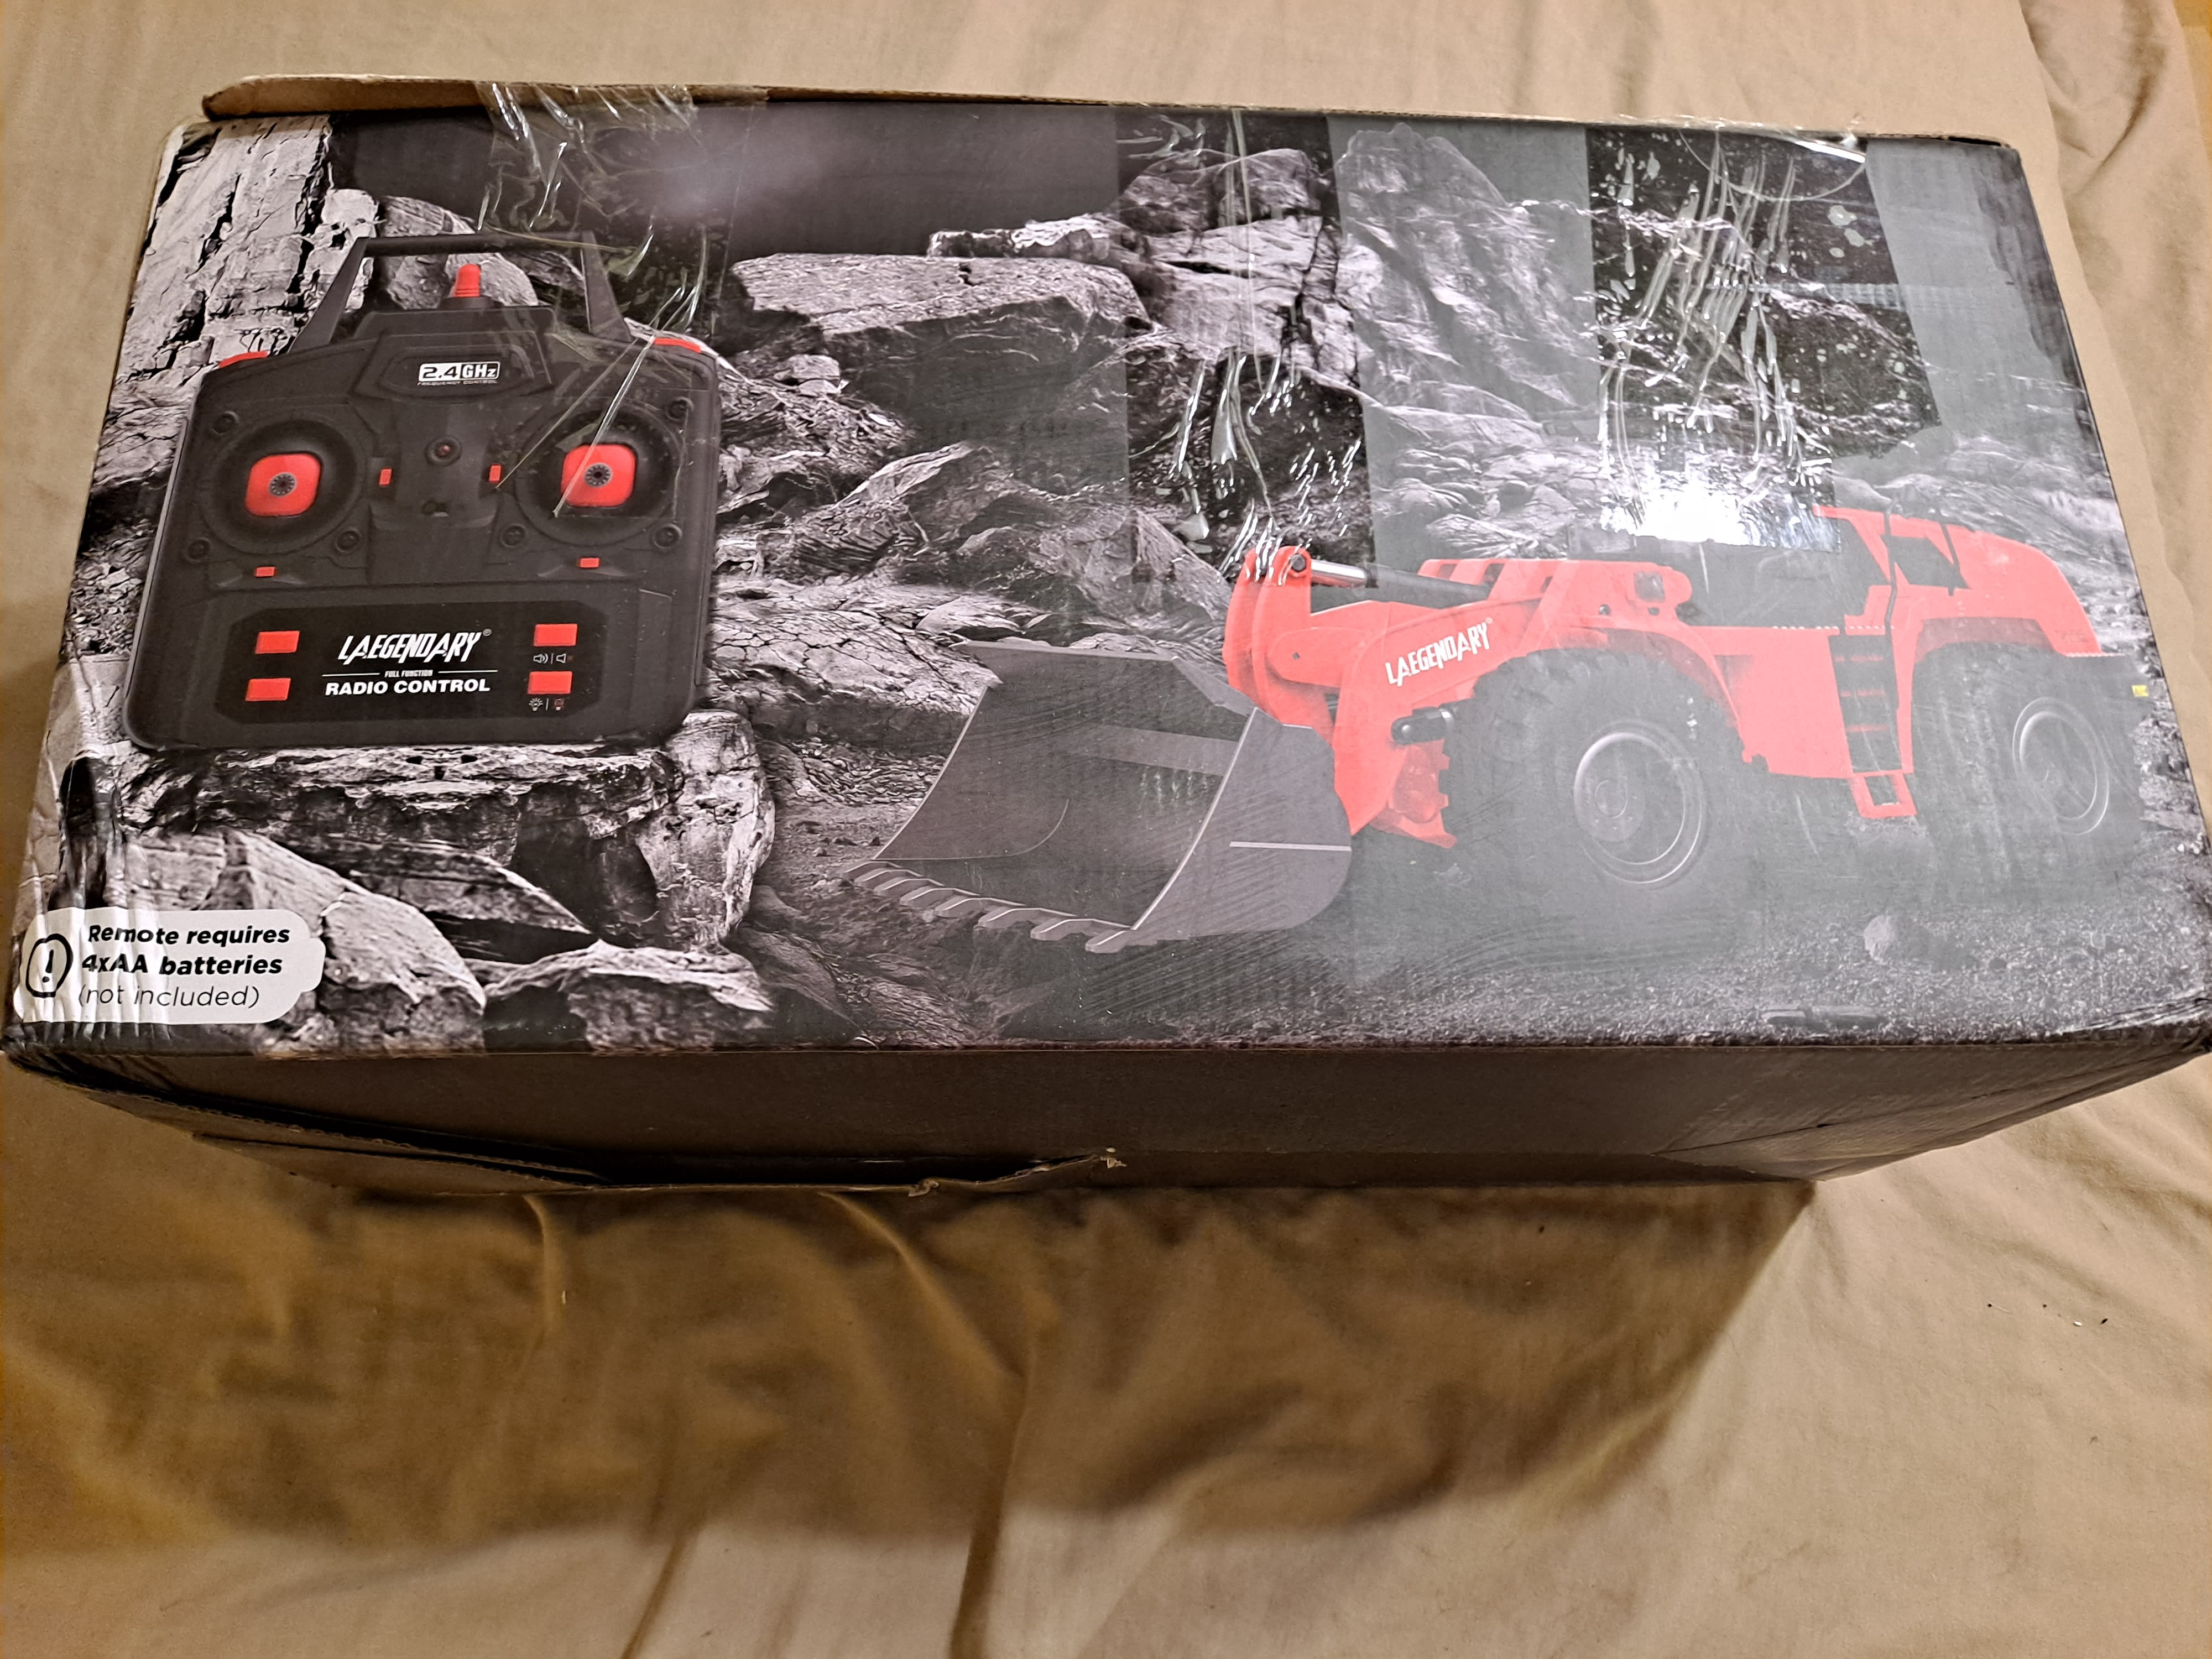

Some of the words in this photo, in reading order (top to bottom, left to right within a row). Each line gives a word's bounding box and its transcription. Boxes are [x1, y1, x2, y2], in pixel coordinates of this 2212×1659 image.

[337, 632, 482, 665] LAEGENDARY
[1385, 622, 1490, 687] LAEGENDARY
[325, 681, 388, 696] RADIO
[394, 679, 491, 693] CONTROL
[88, 925, 179, 944] Remote
[186, 926, 290, 947] requires
[81, 954, 148, 973] 4xAA
[159, 955, 283, 975] batteries
[78, 984, 124, 1006] (not
[134, 985, 260, 1008] included)
